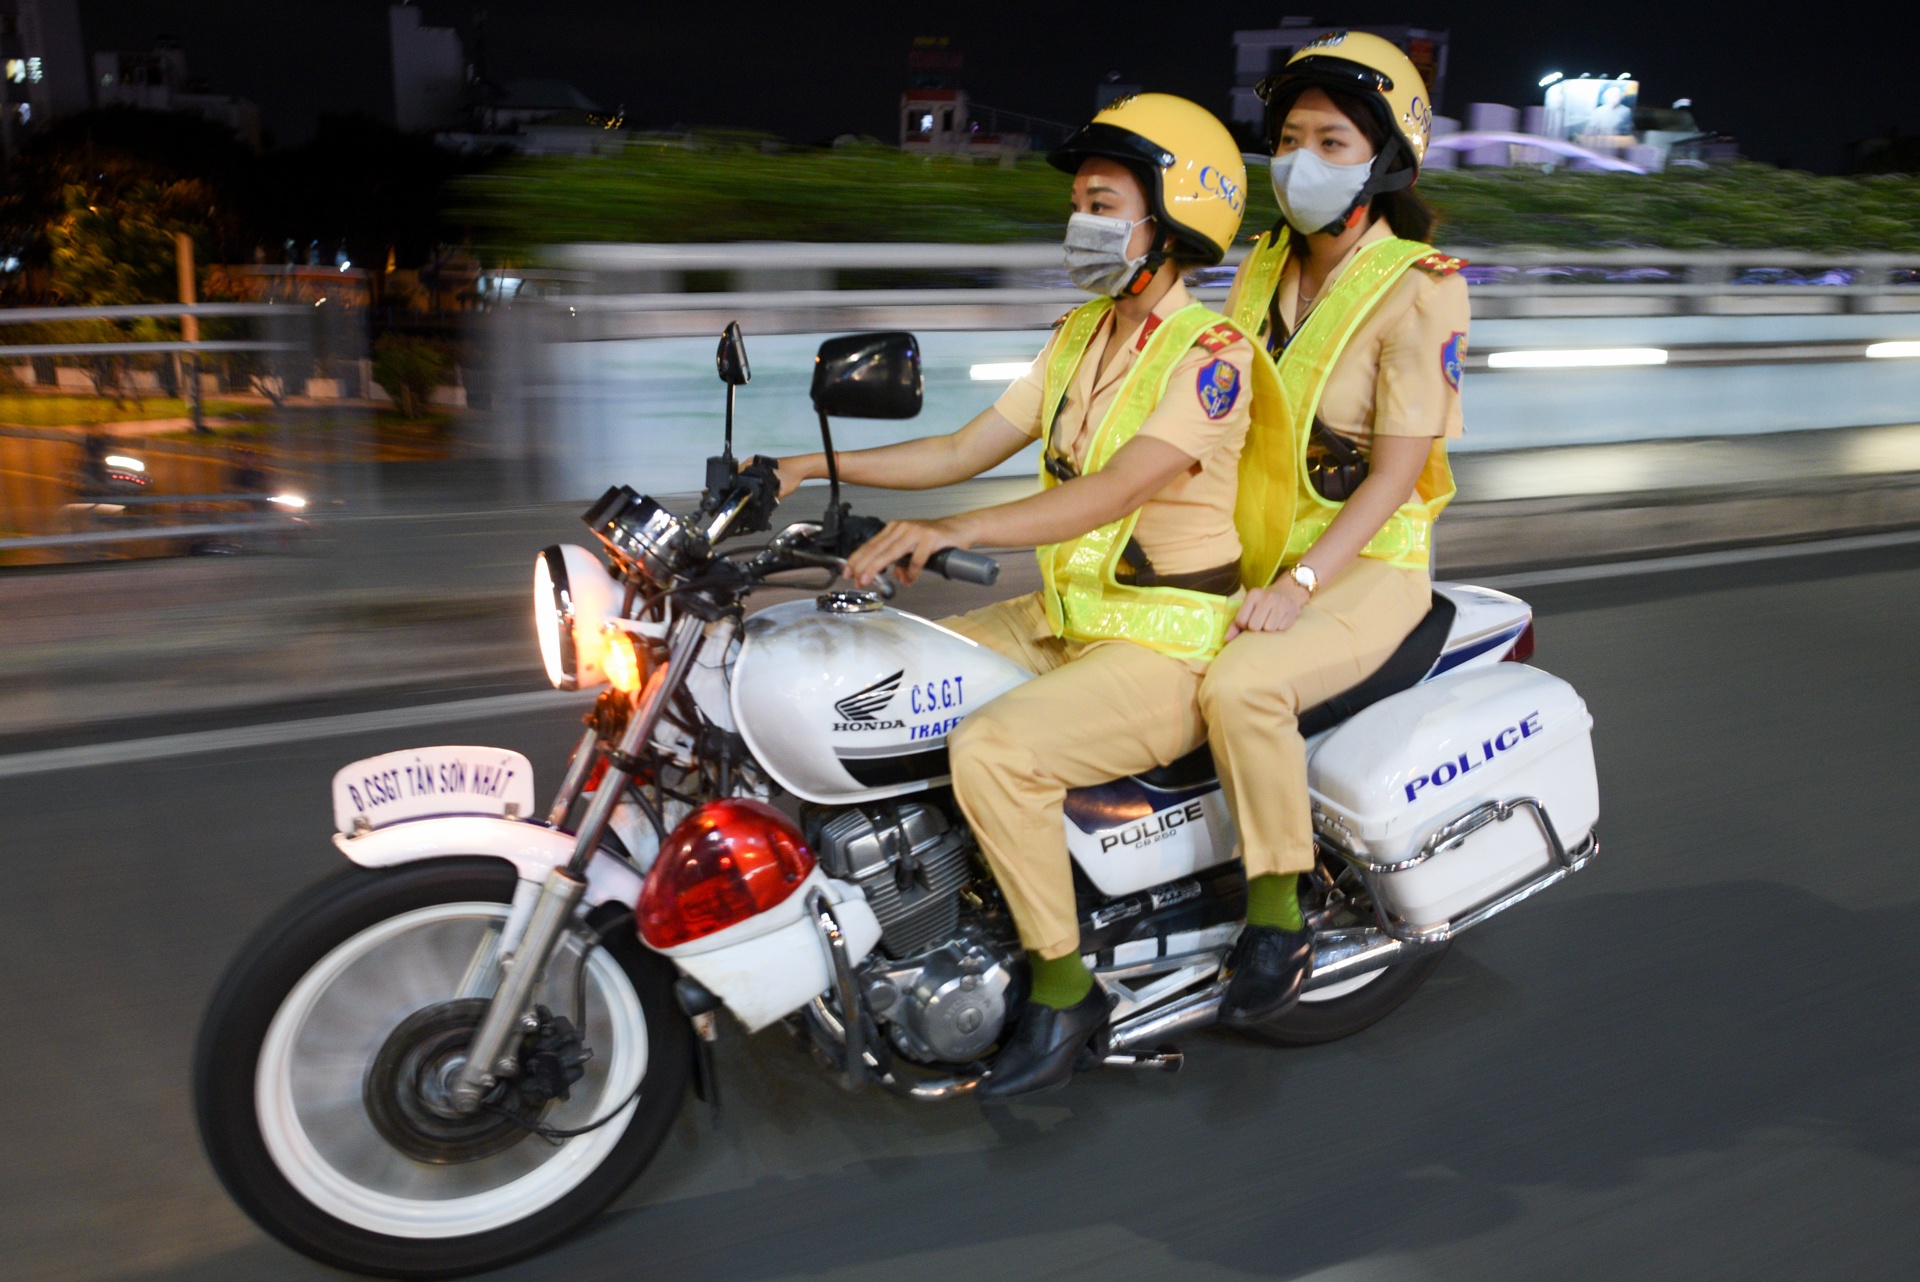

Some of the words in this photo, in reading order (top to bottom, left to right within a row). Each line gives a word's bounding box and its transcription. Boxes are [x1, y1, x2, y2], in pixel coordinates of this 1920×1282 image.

[911, 676, 963, 714] C.S.G.T
[832, 719, 907, 732] HONDA
[910, 716, 966, 740] TRAFF
[1404, 709, 1544, 803] POLICE
[1100, 801, 1204, 854] POLICE
